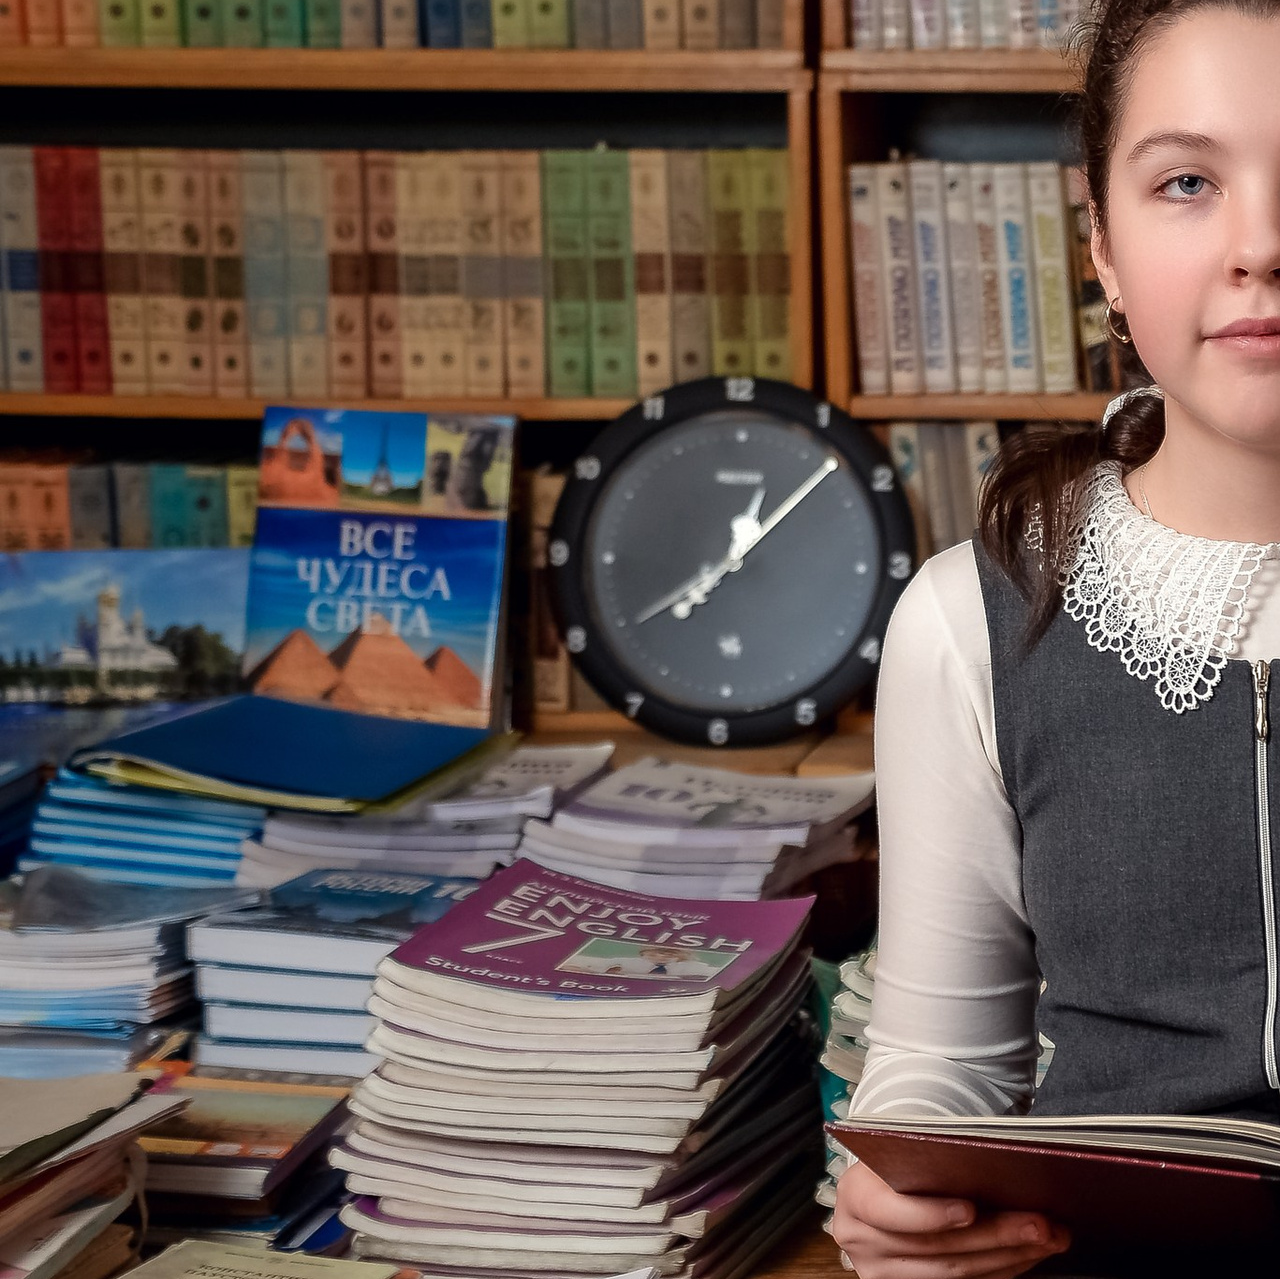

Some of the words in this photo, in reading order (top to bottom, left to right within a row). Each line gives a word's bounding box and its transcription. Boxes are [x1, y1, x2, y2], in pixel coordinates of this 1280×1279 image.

[726, 378, 754, 402] 12
[817, 403, 831, 428] 1
[870, 465, 894, 492] 2
[339, 520, 417, 561] ВСЕ
[549, 539, 569, 567] 9
[297, 557, 452, 601] ЧУДЕСА
[888, 551, 912, 580] 3
[306, 596, 432, 638] СВЕТА
[566, 625, 587, 653] 8
[858, 637, 880, 664] 4
[624, 691, 645, 718] 7
[795, 698, 817, 726] 5
[707, 719, 729, 746] 6
[513, 882, 704, 932] ENJOY
[461, 912, 565, 955] 7
[493, 899, 755, 953] ENGLISH
[425, 956, 550, 986] Student's
[559, 979, 629, 994] Book
